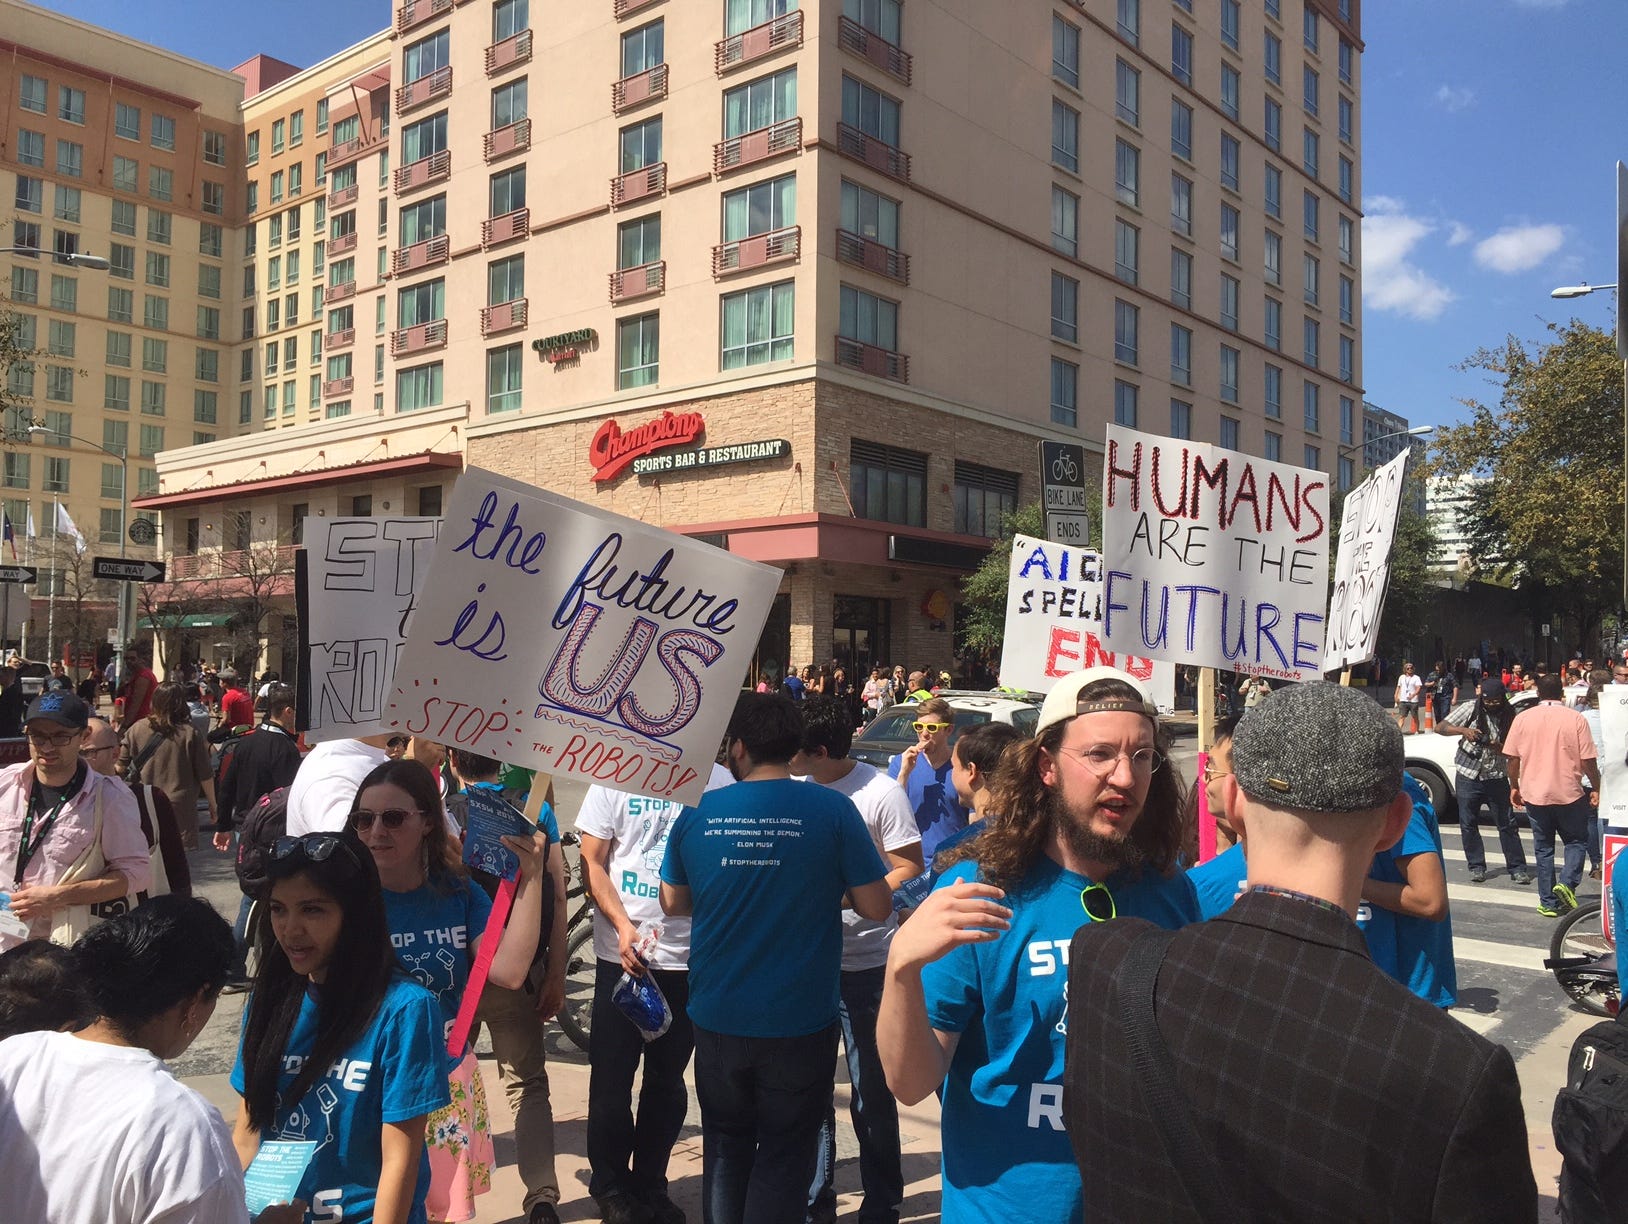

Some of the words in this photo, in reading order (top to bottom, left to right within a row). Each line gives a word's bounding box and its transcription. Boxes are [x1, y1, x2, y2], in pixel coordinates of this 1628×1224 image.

[532, 328, 593, 351] COURTYARD
[590, 411, 705, 474] Champions
[633, 455, 673, 473] SPORTS
[675, 452, 695, 467] BAR
[699, 451, 706, 463] &
[709, 440, 782, 464] RESTAURANT
[1047, 488, 1065, 505] BIKE
[1067, 490, 1085, 507] LANE
[1106, 439, 1325, 544] HUMANS
[1056, 521, 1081, 538] ENDS
[1129, 511, 1210, 567] ARE
[1234, 537, 1318, 585] THE
[2, 570, 20, 578] WAY
[100, 563, 121, 573] ONE
[124, 565, 144, 575] WAY
[452, 490, 546, 576] the
[551, 532, 739, 635] future
[1105, 570, 1325, 671] FUTURE
[434, 583, 508, 661] is
[538, 601, 725, 738] US
[406, 697, 511, 747] STOP
[531, 741, 554, 756] THE
[553, 734, 699, 797] ROBOTS!
[469, 799, 494, 814] SXSW
[759, 817, 803, 826] INTELLIGENCE
[621, 869, 659, 899] ROB
[905, 878, 921, 890] STOP
[423, 925, 467, 949] THE
[325, 1057, 372, 1092] HE
[255, 1153, 284, 1162] ROBOTS
[260, 1145, 279, 1154] STOP
[279, 1145, 292, 1154] THE
